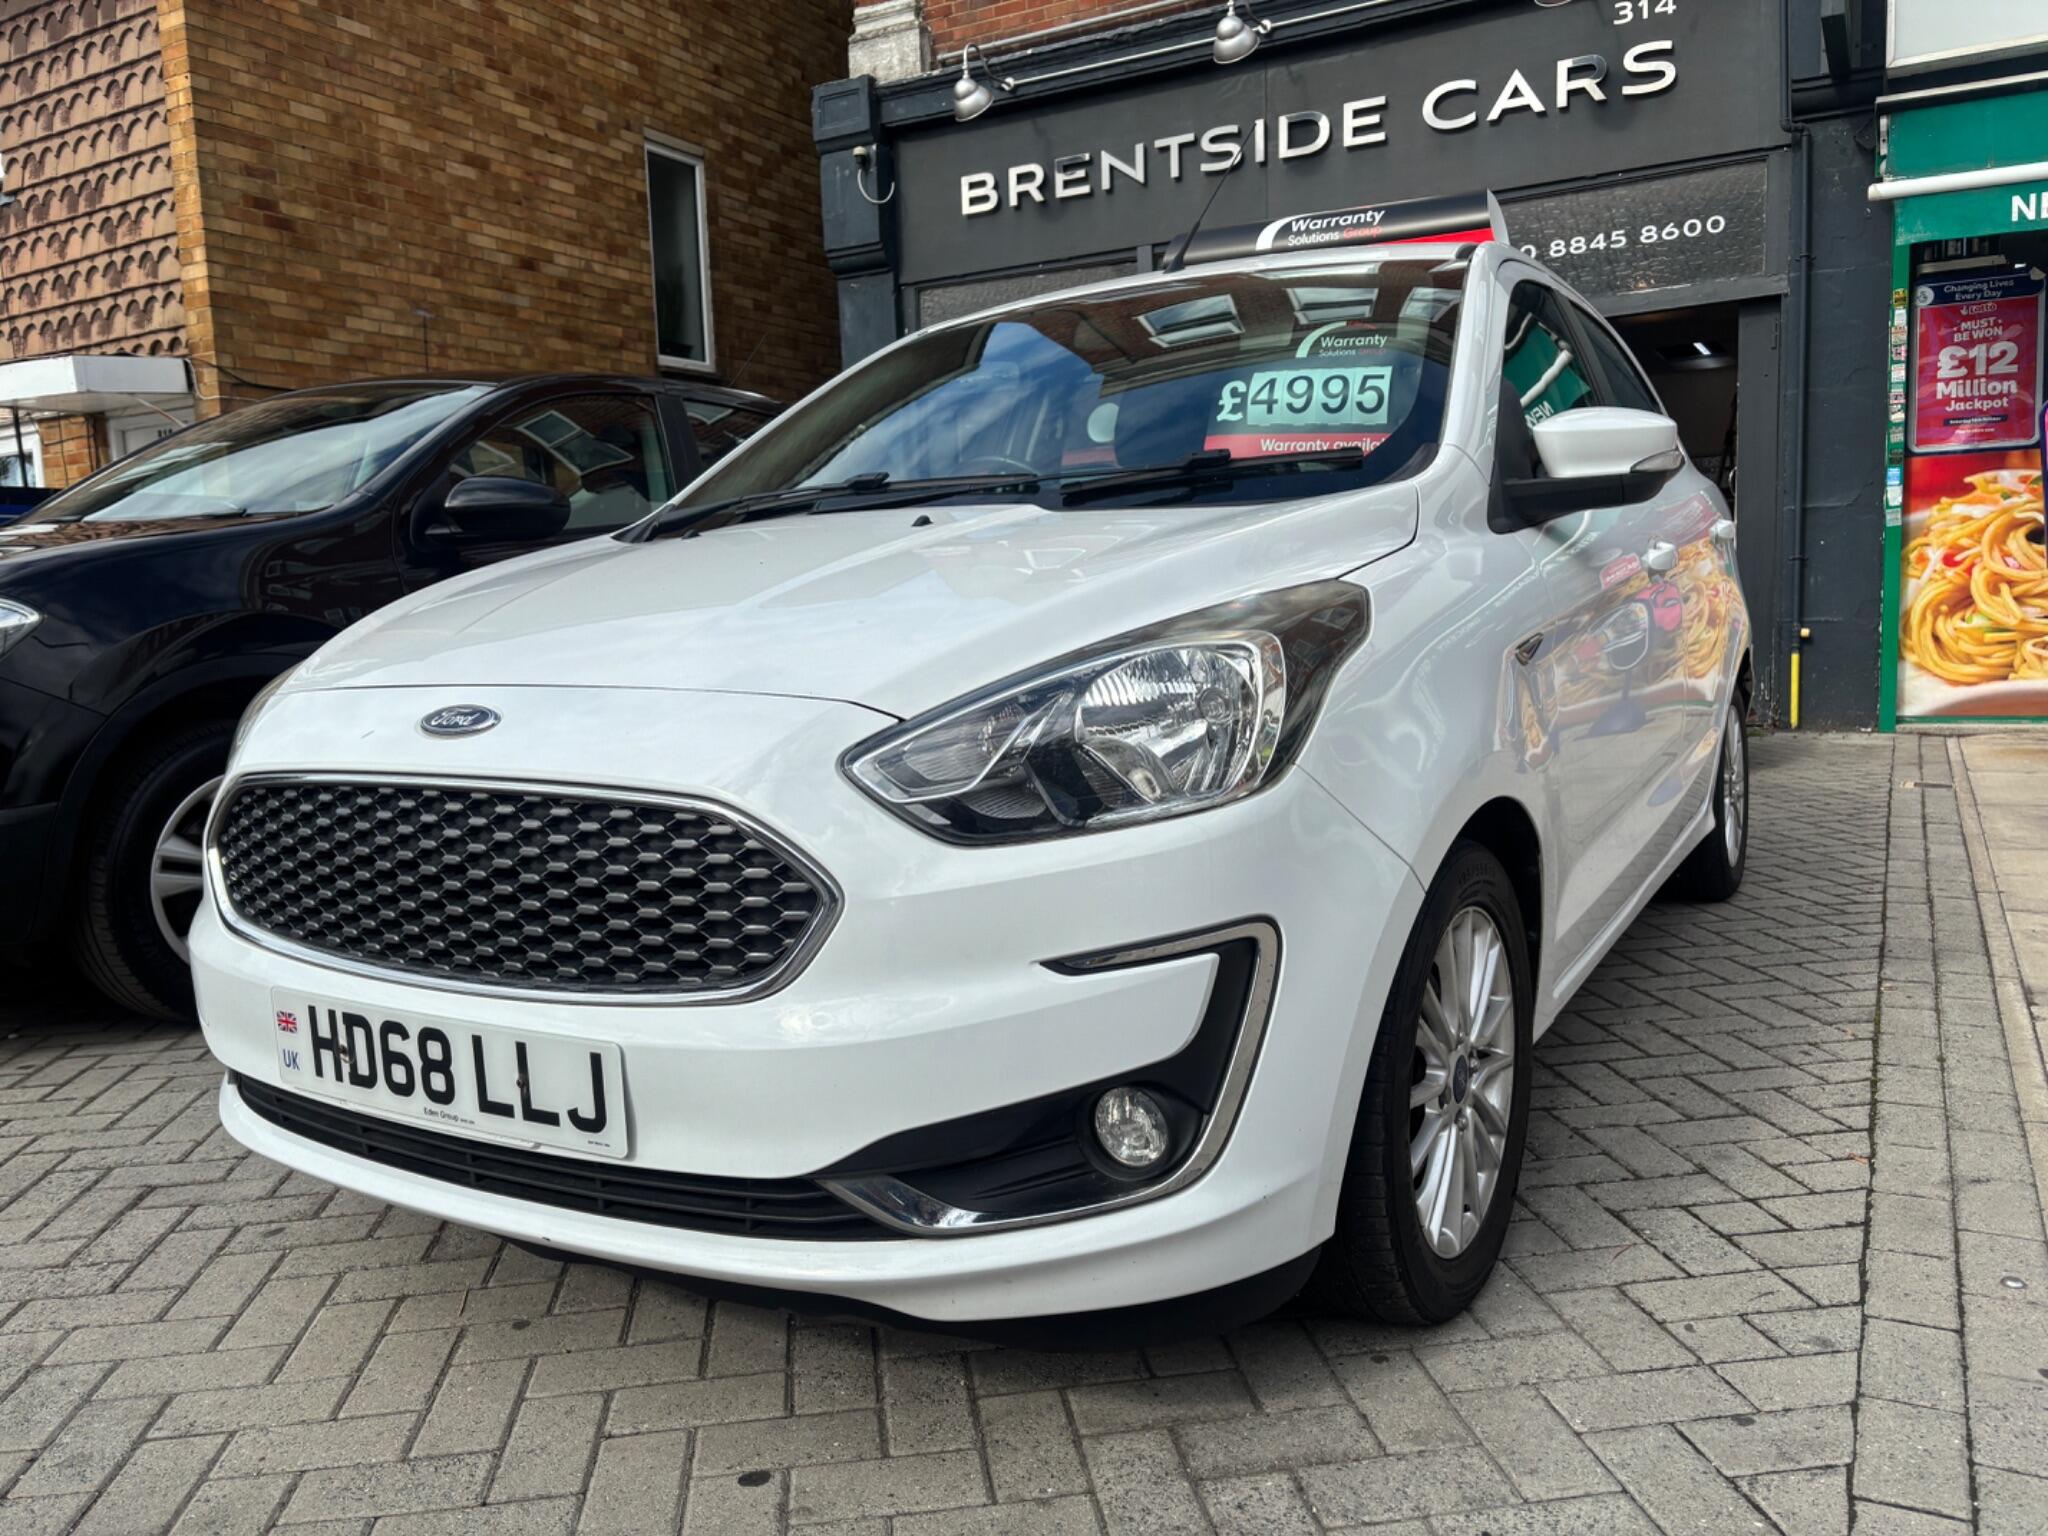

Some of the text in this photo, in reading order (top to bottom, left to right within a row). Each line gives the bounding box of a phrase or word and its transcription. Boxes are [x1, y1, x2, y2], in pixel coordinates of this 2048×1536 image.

[1613, 0, 1677, 25] 314
[960, 40, 1677, 216] BRENTSIDE CARS
[1290, 209, 1386, 233] Warranty
[1287, 225, 1383, 246] Solutions Group
[1549, 229, 1627, 258] 8845
[1639, 215, 1726, 244] 8600
[1944, 279, 2015, 293] Changing Lives
[1955, 289, 2003, 301] Every Day
[1953, 325, 2004, 342] BE WON
[1960, 317, 1998, 331] MUST
[1320, 334, 1388, 348] Warranty
[1319, 348, 1356, 358] Solutions
[1936, 340, 2019, 379] £12
[1216, 374, 1386, 422] £4995
[1936, 377, 2018, 400] Million
[1945, 396, 2009, 411] Jackpot
[1260, 437, 1329, 452] Warranty
[430, 709, 481, 726] Ford
[283, 1048, 300, 1070] UK
[471, 1034, 607, 1134] LLJ
